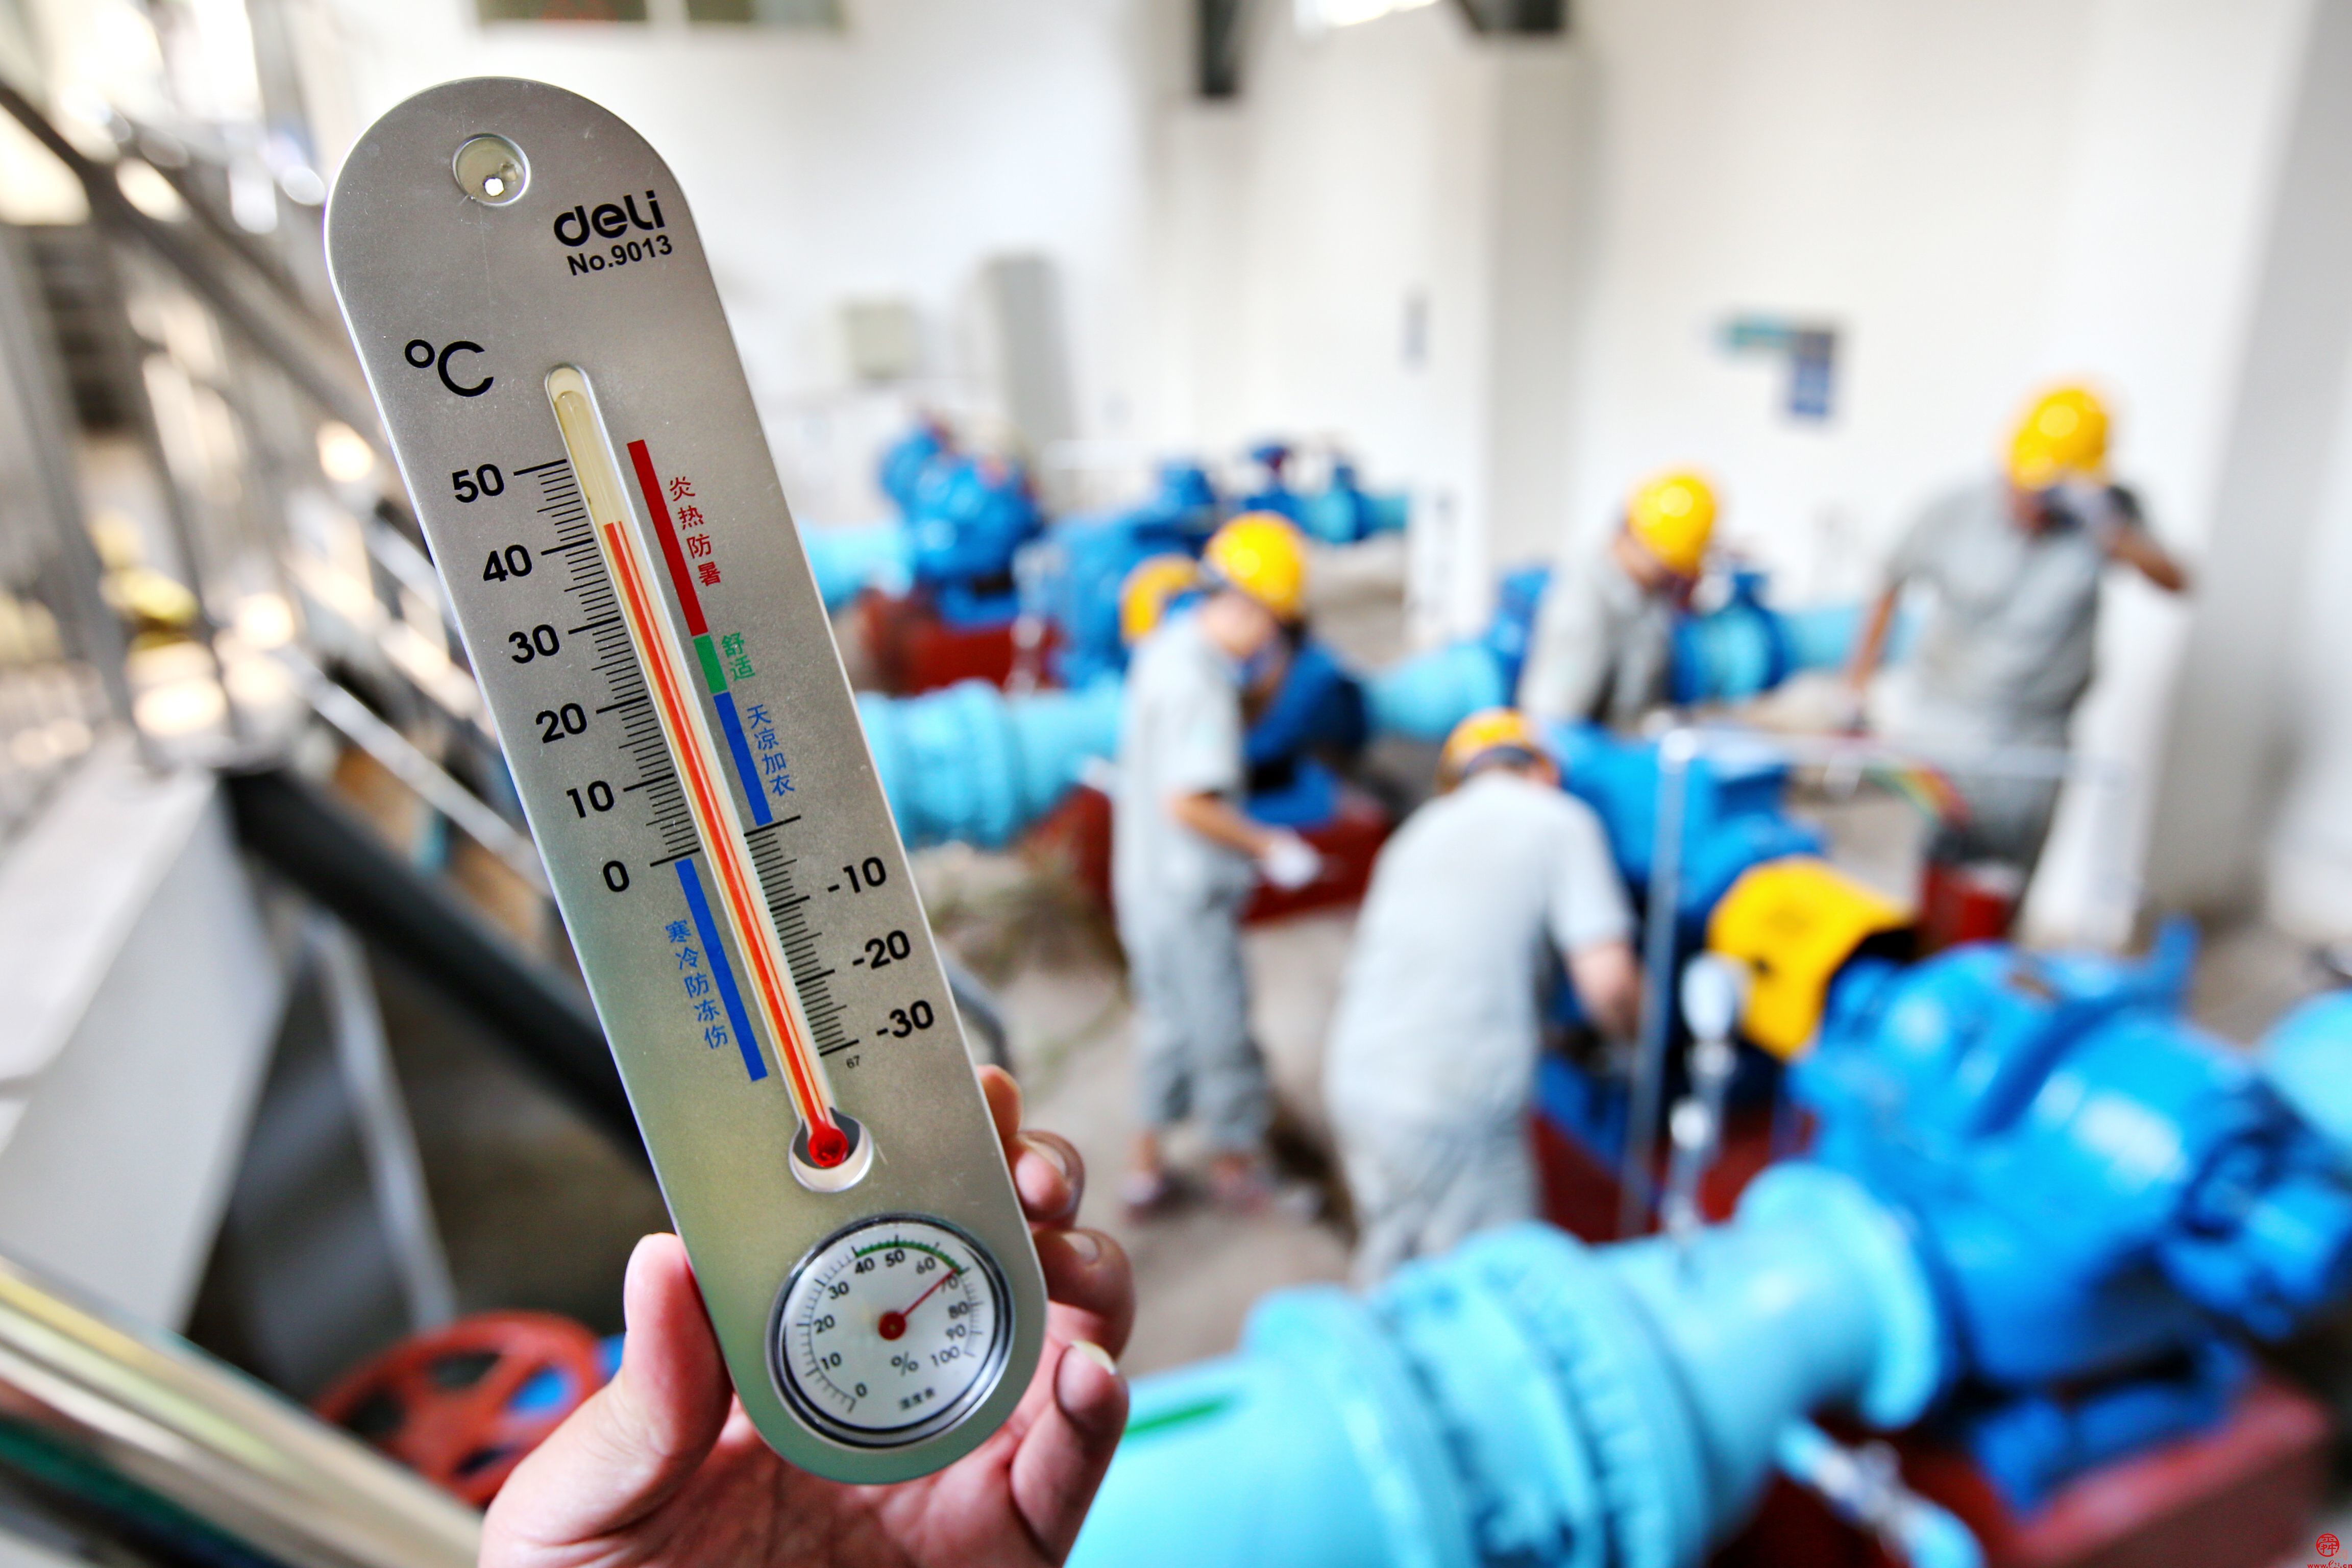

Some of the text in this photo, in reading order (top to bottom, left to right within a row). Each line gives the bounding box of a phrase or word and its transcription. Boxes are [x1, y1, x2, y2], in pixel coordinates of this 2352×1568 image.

[554, 190, 665, 247] deli
[567, 235, 672, 276] No.9013
[452, 463, 505, 503] 50
[669, 476, 721, 587] 炎热防暑
[482, 544, 532, 583] 40
[508, 624, 560, 664] 30
[721, 632, 755, 681] 舒适
[535, 703, 587, 743] 20
[746, 704, 795, 797] 天凉加衣
[566, 780, 615, 818] 10
[603, 860, 630, 892] 0
[827, 856, 887, 893] -10
[852, 930, 911, 970] -20
[665, 920, 729, 1049] 寒冷防冻伤
[876, 999, 934, 1039] -30
[846, 1055, 860, 1069] 67
[854, 1257, 875, 1275] 40
[885, 1249, 905, 1267] 50
[916, 1257, 936, 1275] 60
[828, 1281, 849, 1300] 30
[814, 1314, 835, 1334] 20
[948, 1301, 968, 1318] 80
[946, 1325, 966, 1341] 90
[820, 1352, 842, 1371] 10
[891, 1352, 919, 1377] %
[930, 1346, 960, 1367] 100
[855, 1382, 867, 1397] 0
